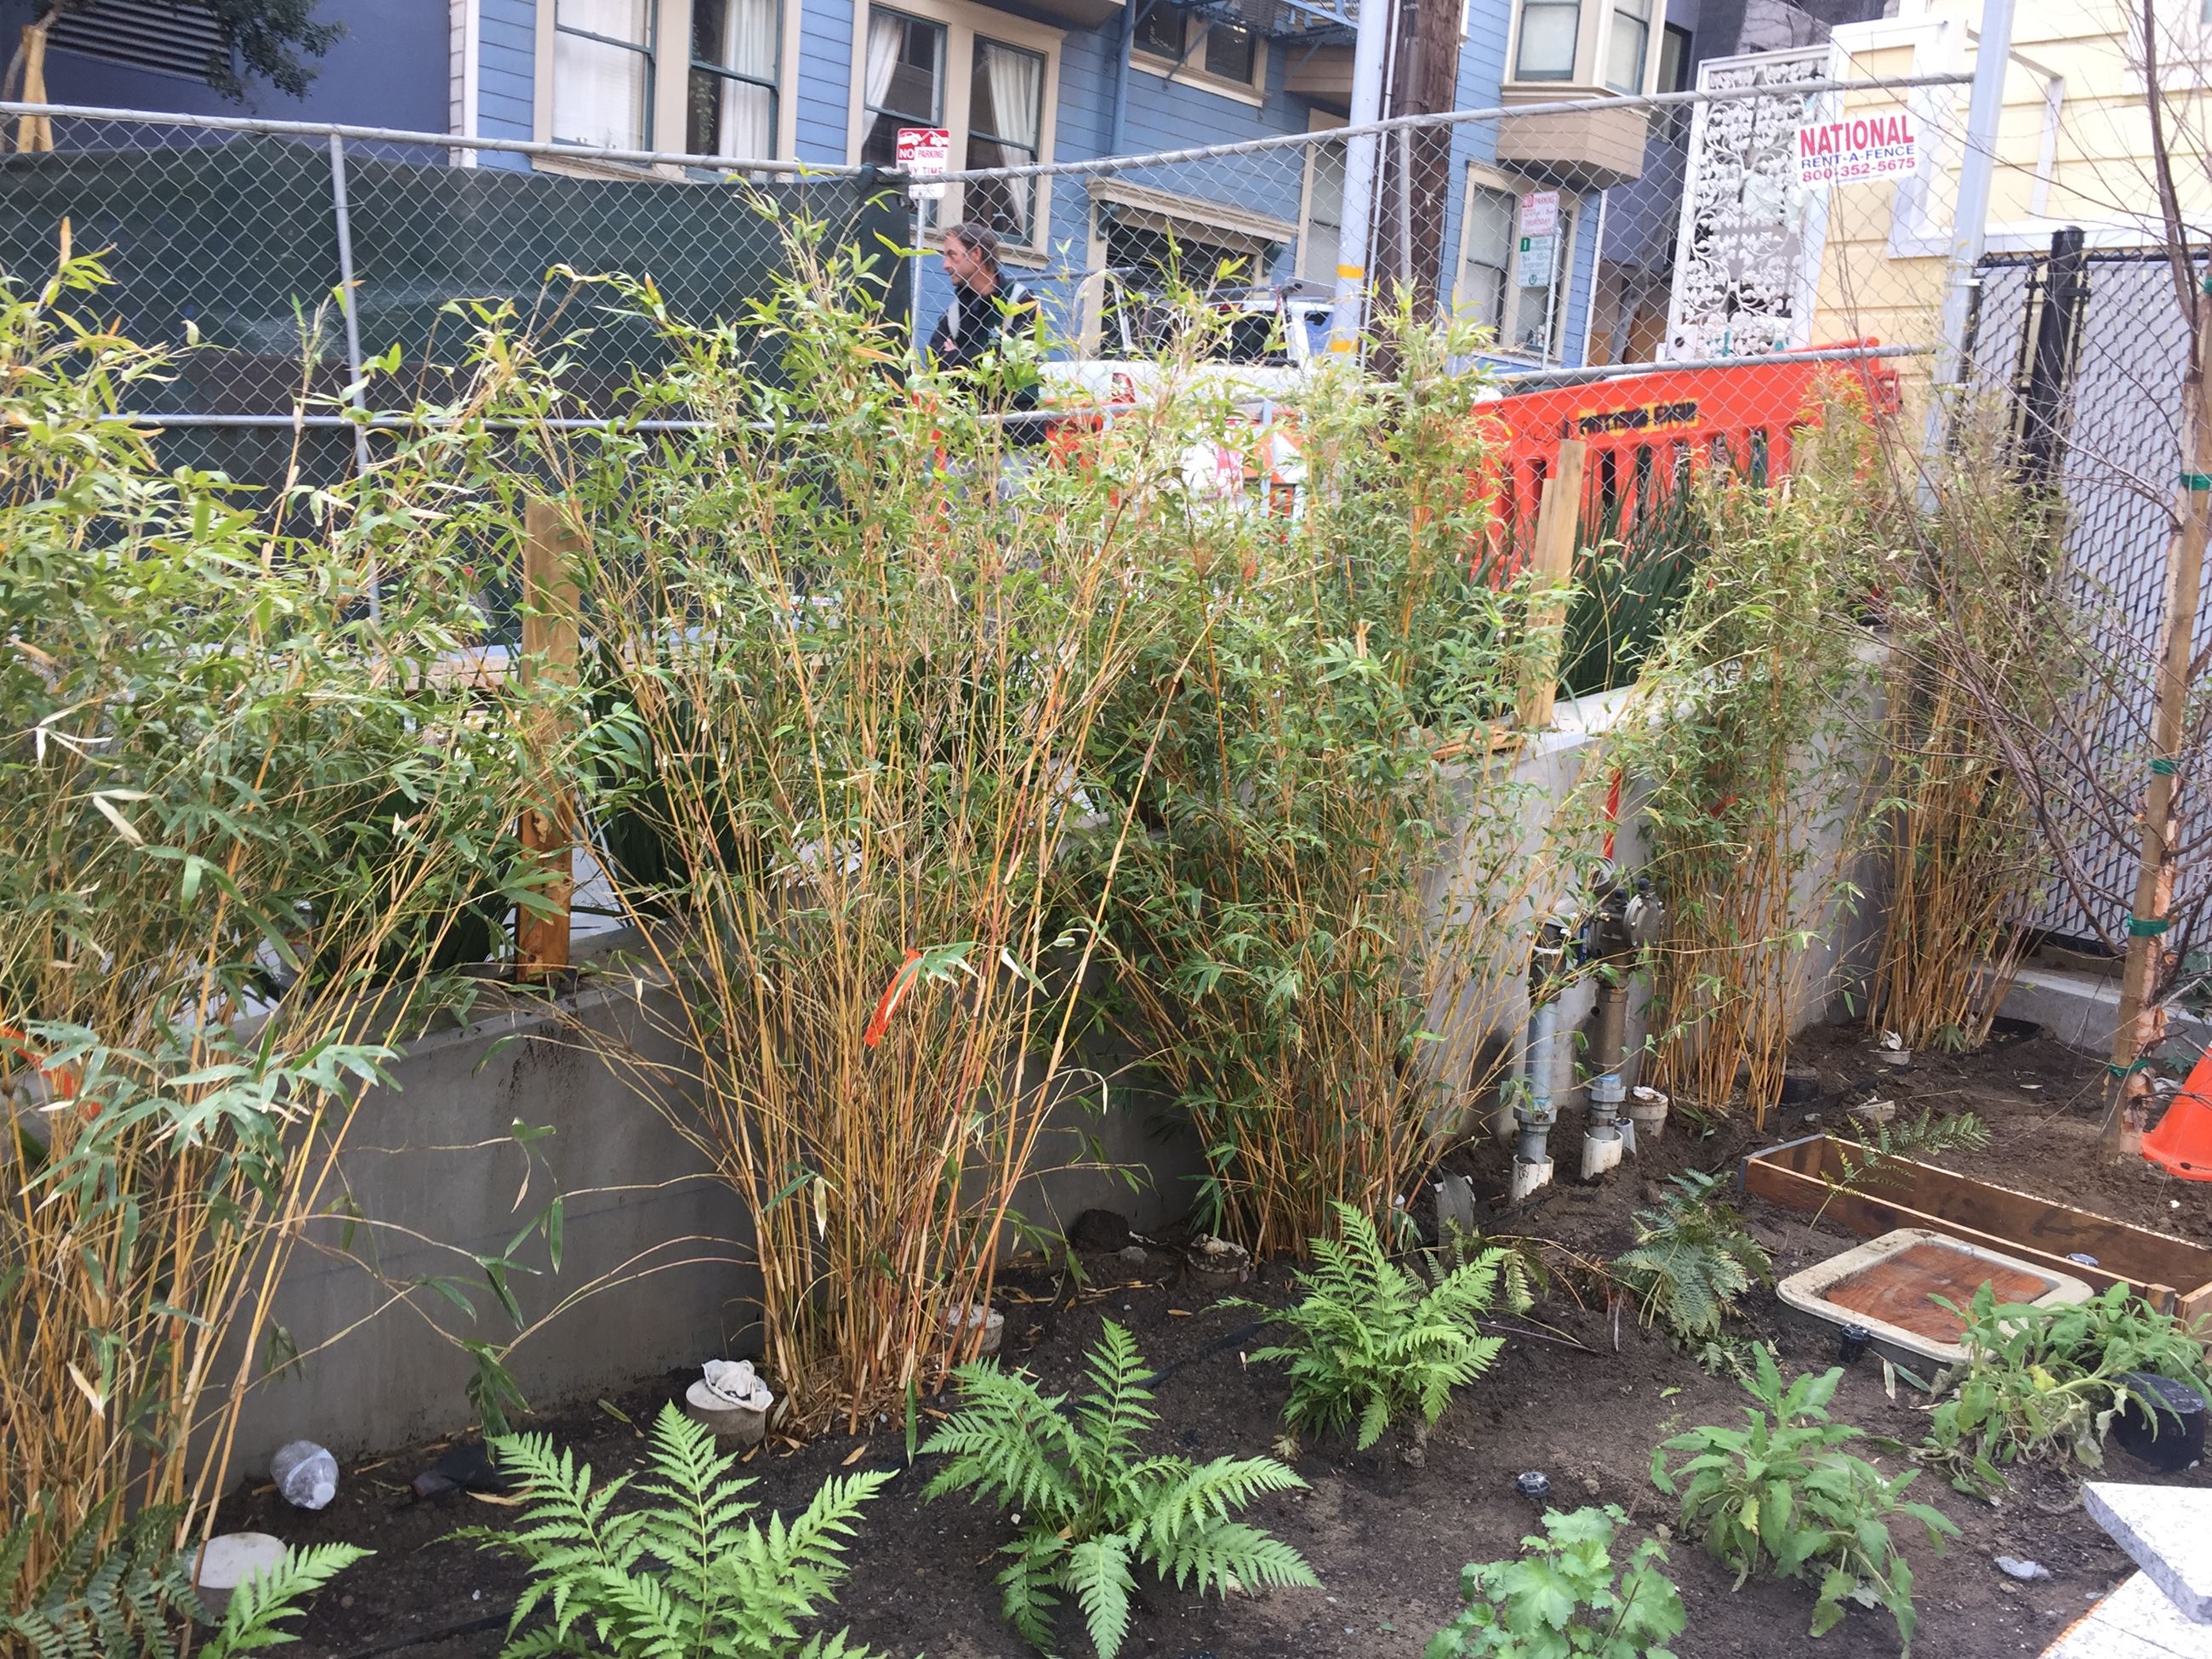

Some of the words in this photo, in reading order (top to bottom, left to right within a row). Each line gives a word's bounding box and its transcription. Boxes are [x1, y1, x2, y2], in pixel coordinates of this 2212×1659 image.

[1800, 115, 1914, 157] NATIONAL
[898, 148, 914, 159] NO
[918, 150, 944, 158] PARKING
[1801, 145, 1915, 169] RENT-A-FENCE
[1802, 158, 1915, 182] 800-352-5675
